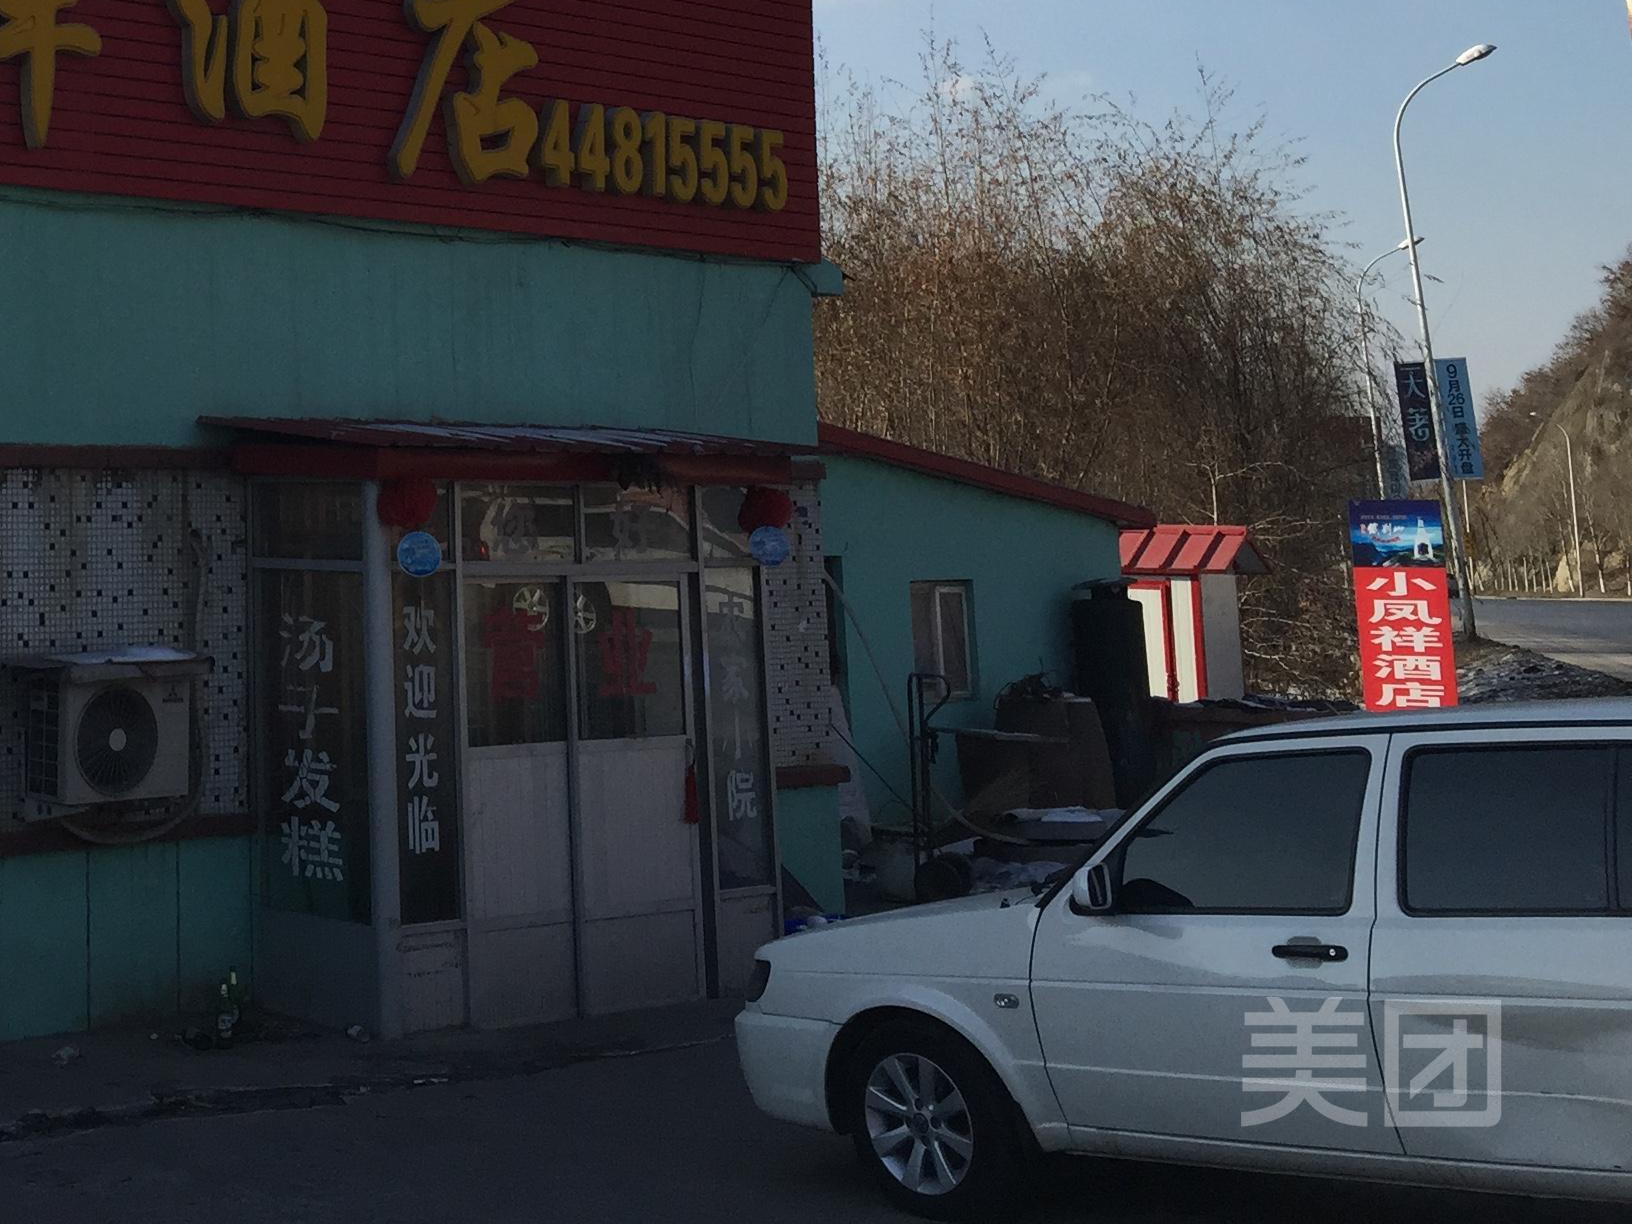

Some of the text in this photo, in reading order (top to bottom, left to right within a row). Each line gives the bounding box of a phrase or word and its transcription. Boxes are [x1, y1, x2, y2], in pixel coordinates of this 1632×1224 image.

[540, 98, 789, 212] 44815555
[484, 608, 657, 702] 营业
[1366, 570, 1446, 709] 小凤祥酒店
[402, 604, 441, 856] 欢迎光临
